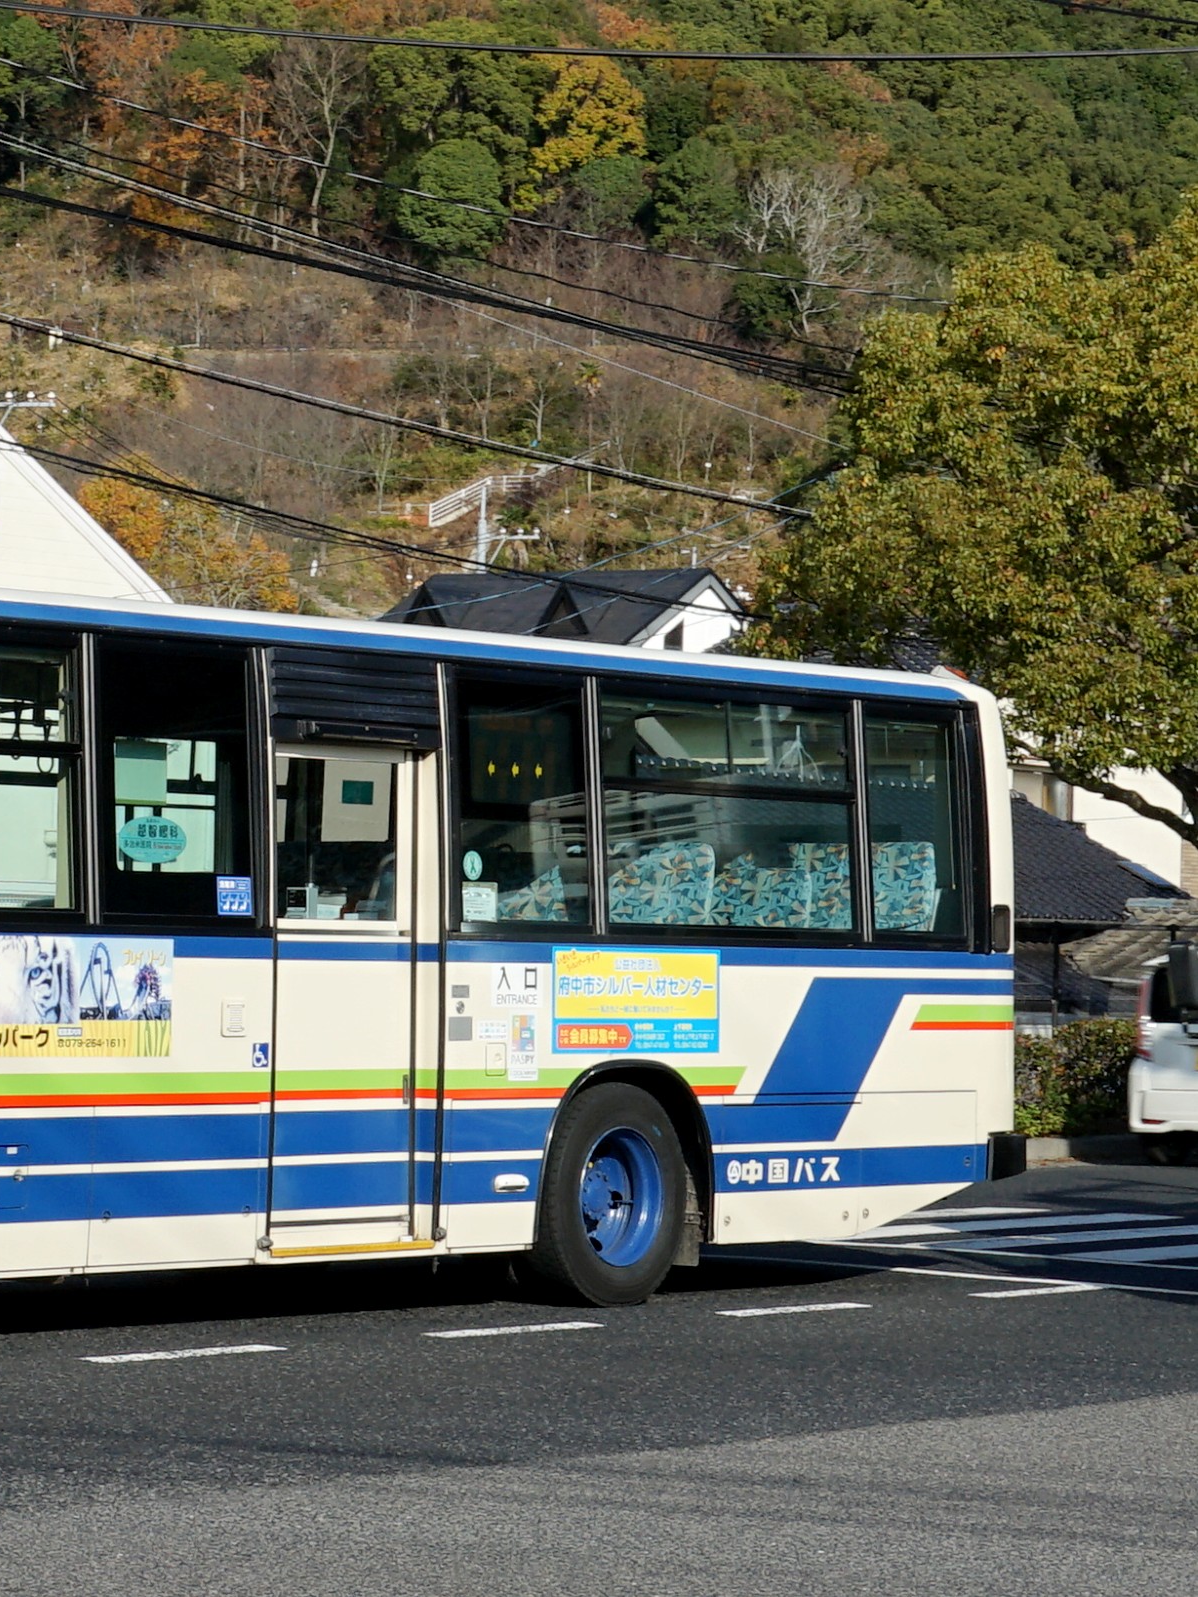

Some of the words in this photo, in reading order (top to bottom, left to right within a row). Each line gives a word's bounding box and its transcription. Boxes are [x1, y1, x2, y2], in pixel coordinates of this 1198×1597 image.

[497, 966, 537, 989] 入口
[558, 976, 714, 997] 府中市シルバー人材センター
[496, 994, 537, 1005] ENTRANCE
[511, 1055, 535, 1064] PASPY
[742, 1157, 840, 1184] 中国バス
